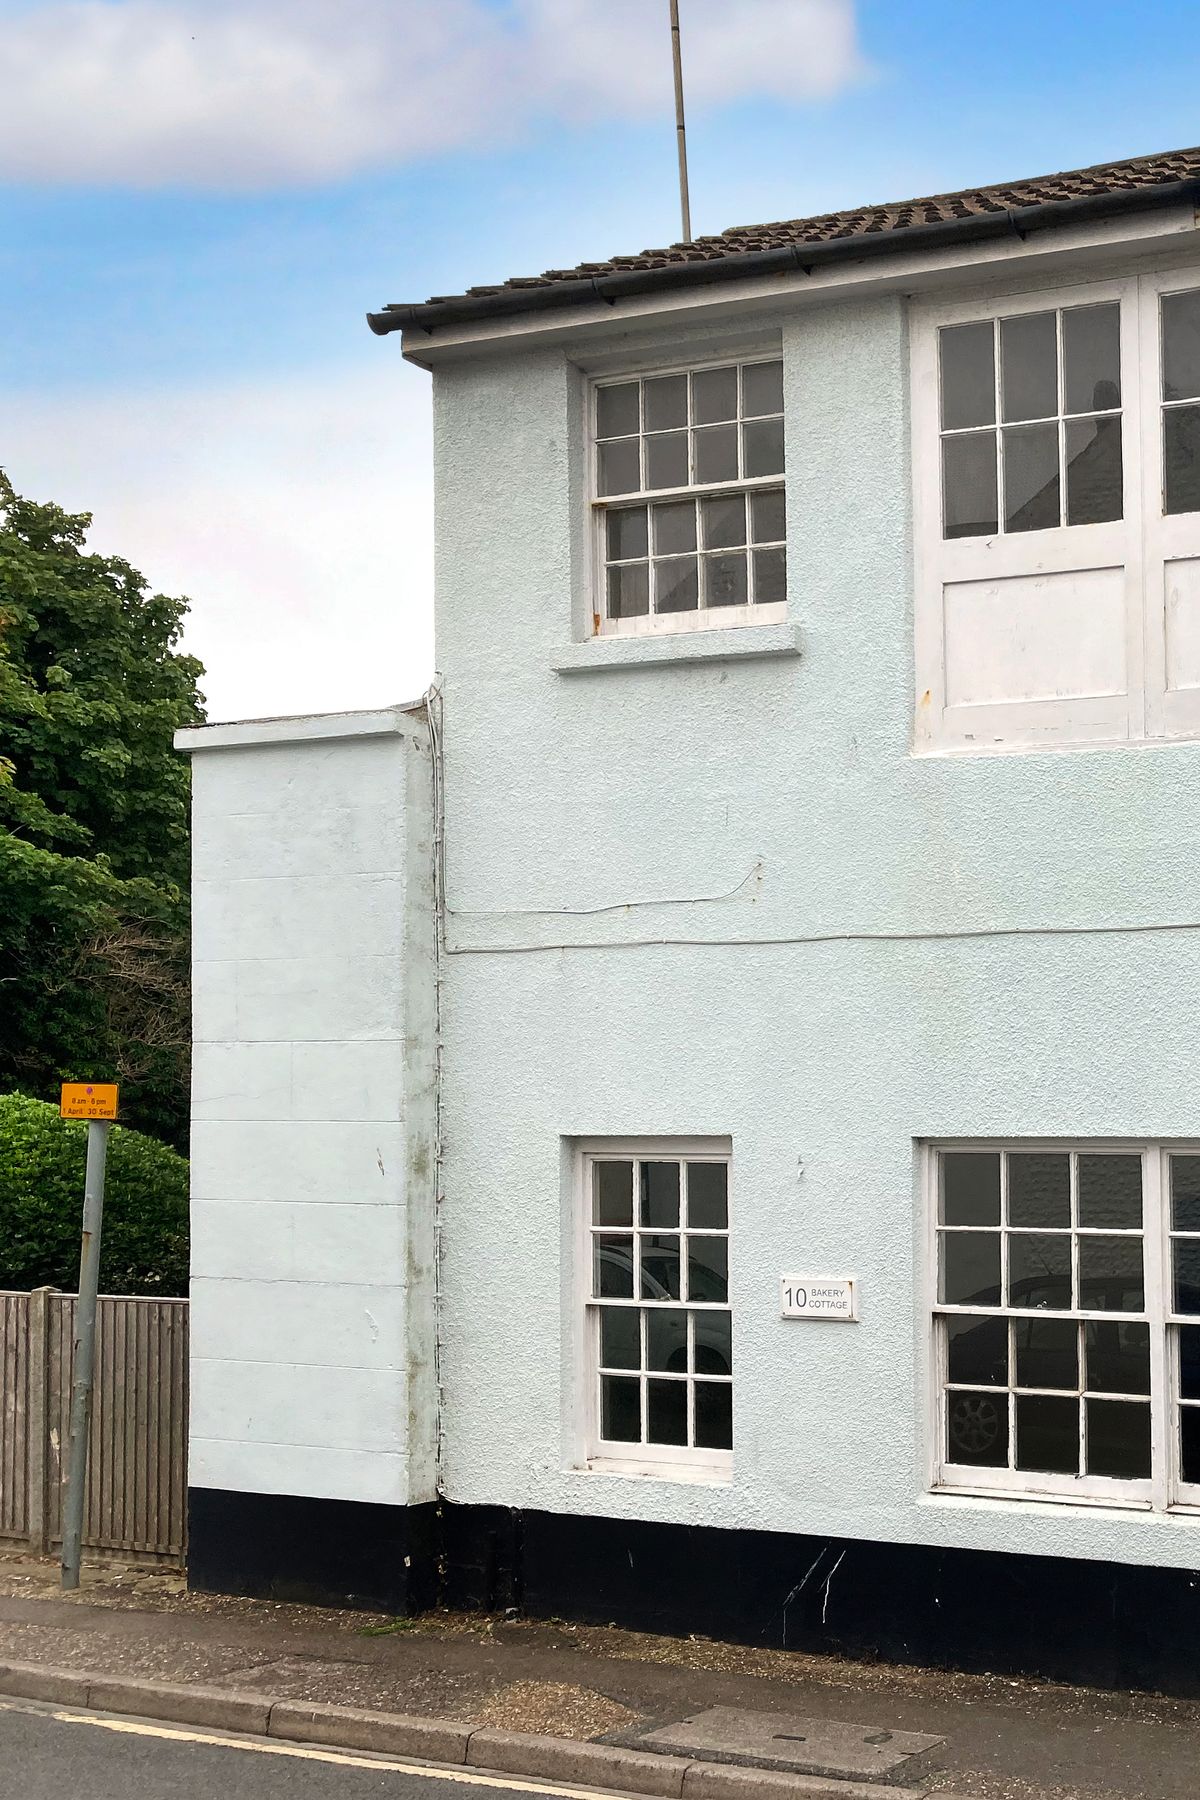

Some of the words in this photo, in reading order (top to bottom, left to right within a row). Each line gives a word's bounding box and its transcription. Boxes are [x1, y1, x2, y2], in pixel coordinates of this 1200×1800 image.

[812, 1289, 844, 1297] BAKERY
[785, 1288, 807, 1308] 10
[808, 1300, 848, 1309] COTTAGE
